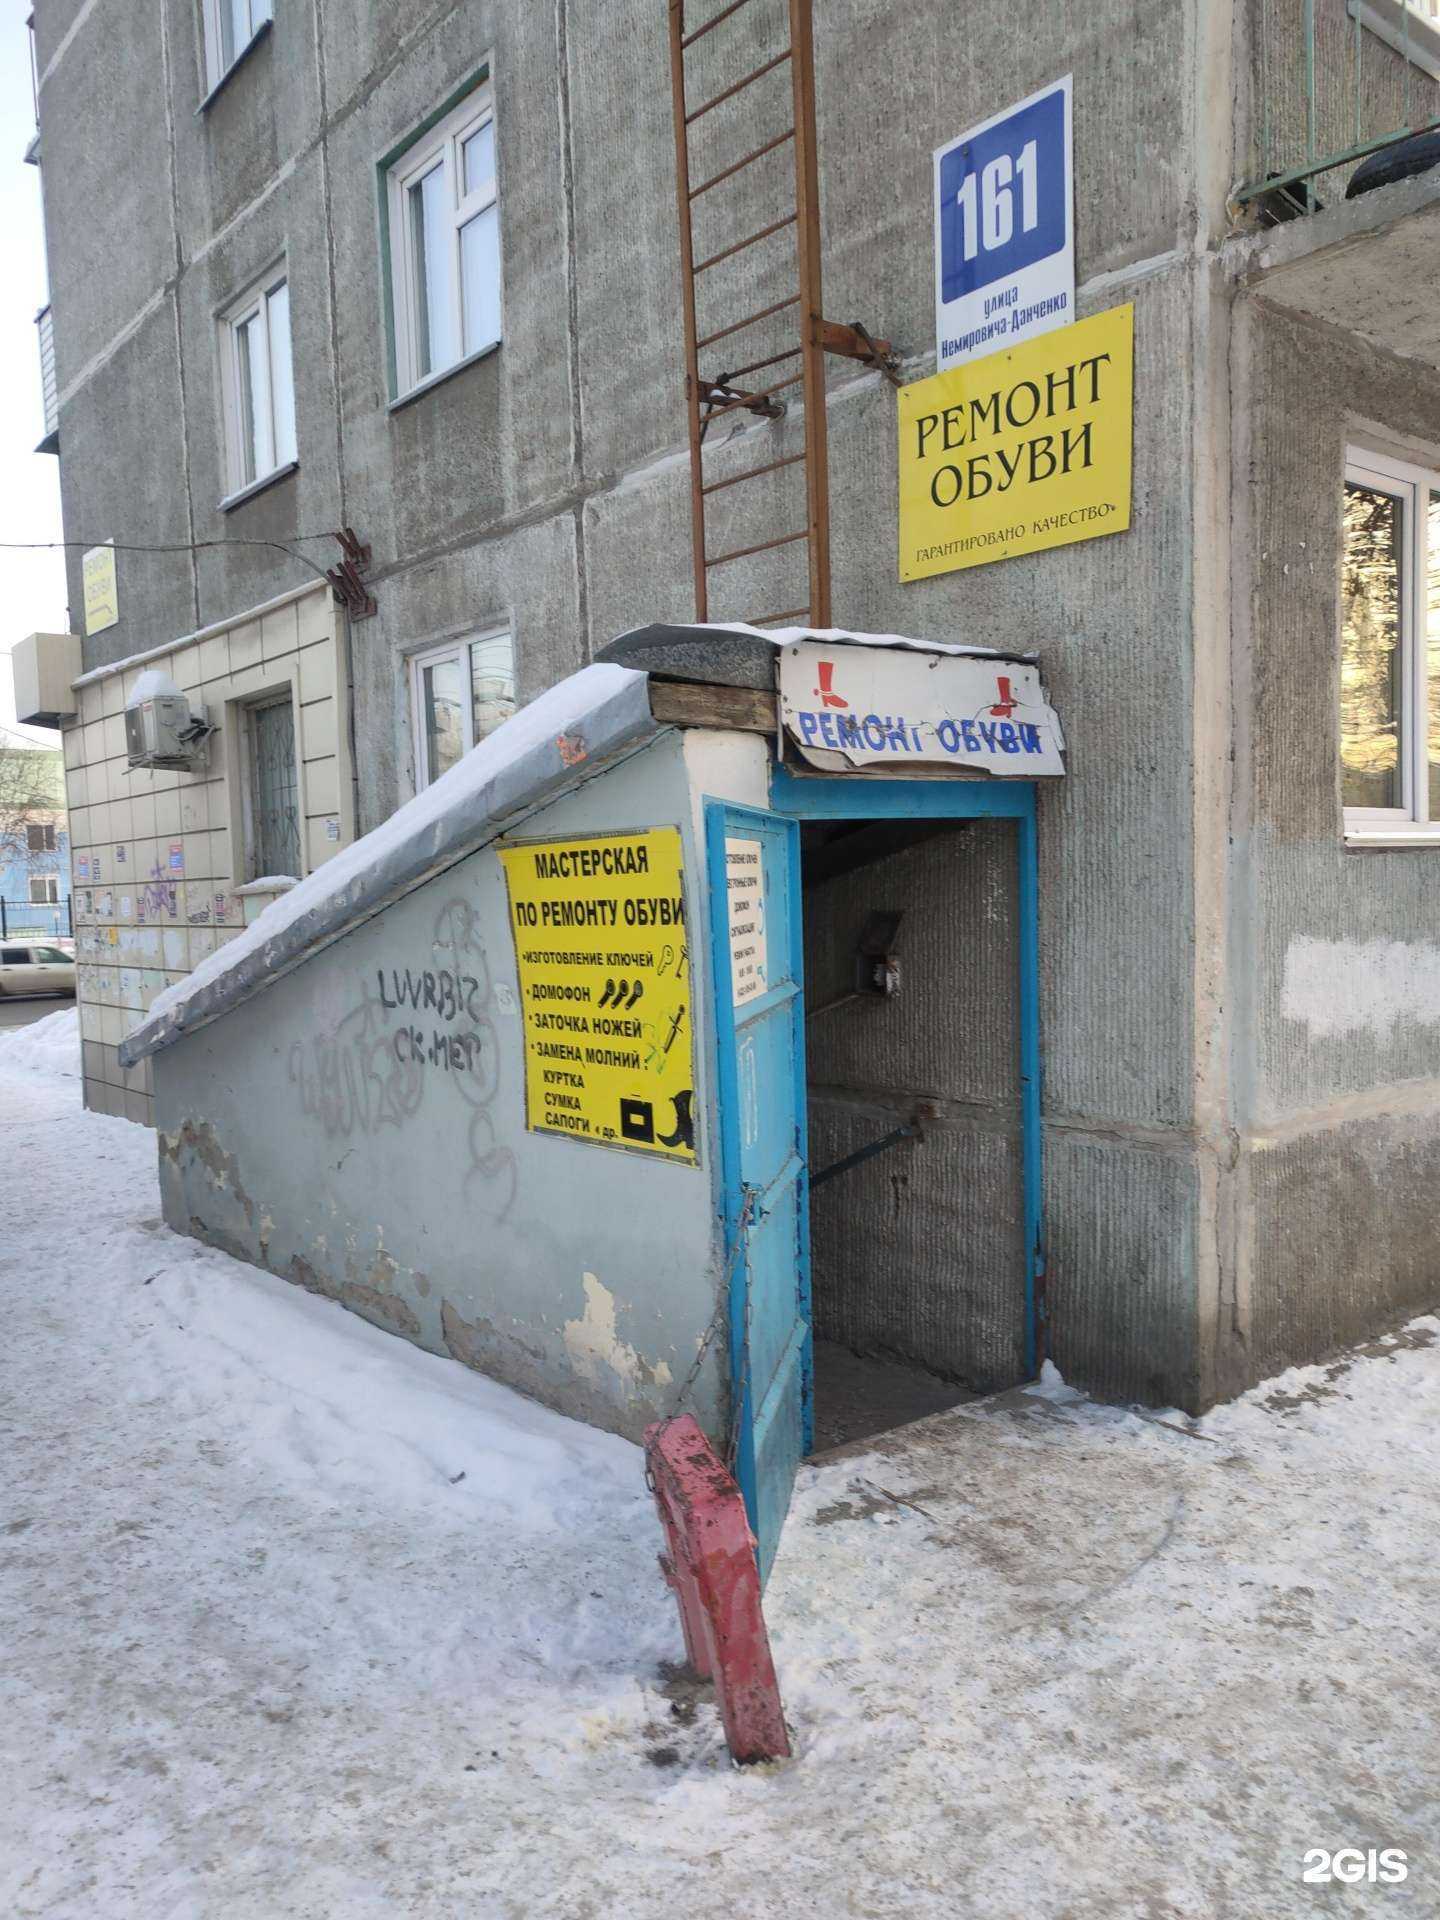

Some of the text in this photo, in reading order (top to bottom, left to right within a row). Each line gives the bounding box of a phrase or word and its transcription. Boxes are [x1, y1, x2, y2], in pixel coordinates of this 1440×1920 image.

[957, 139, 1038, 262] 161
[984, 286, 1018, 319] улица
[942, 292, 1067, 358] Немировича-Данченко
[915, 353, 1111, 459] РЕМОНТ
[930, 421, 1093, 507] ОБУВИ
[916, 503, 1110, 562] ГАРАНТИРОВАНО КАЧЕСТВО
[937, 719, 1043, 754] ОБУВИ
[535, 846, 649, 878] МАСТЕРСКАЯ
[515, 898, 686, 926] ПО РЕМОНТУ ОБУВИ
[526, 951, 654, 967] ИЗГОТОВЛЕНИЕ КЛЮЧЕЙ
[532, 984, 591, 1002] ДОМОФОН
[535, 1013, 643, 1038] ЗАТОЧКА НОЖЕЙ
[537, 1042, 583, 1063] ЗАМЕНА
[543, 1070, 585, 1088] КУРТКА
[544, 1092, 582, 1111] СУМКА
[545, 1112, 590, 1133] САПОГИ
